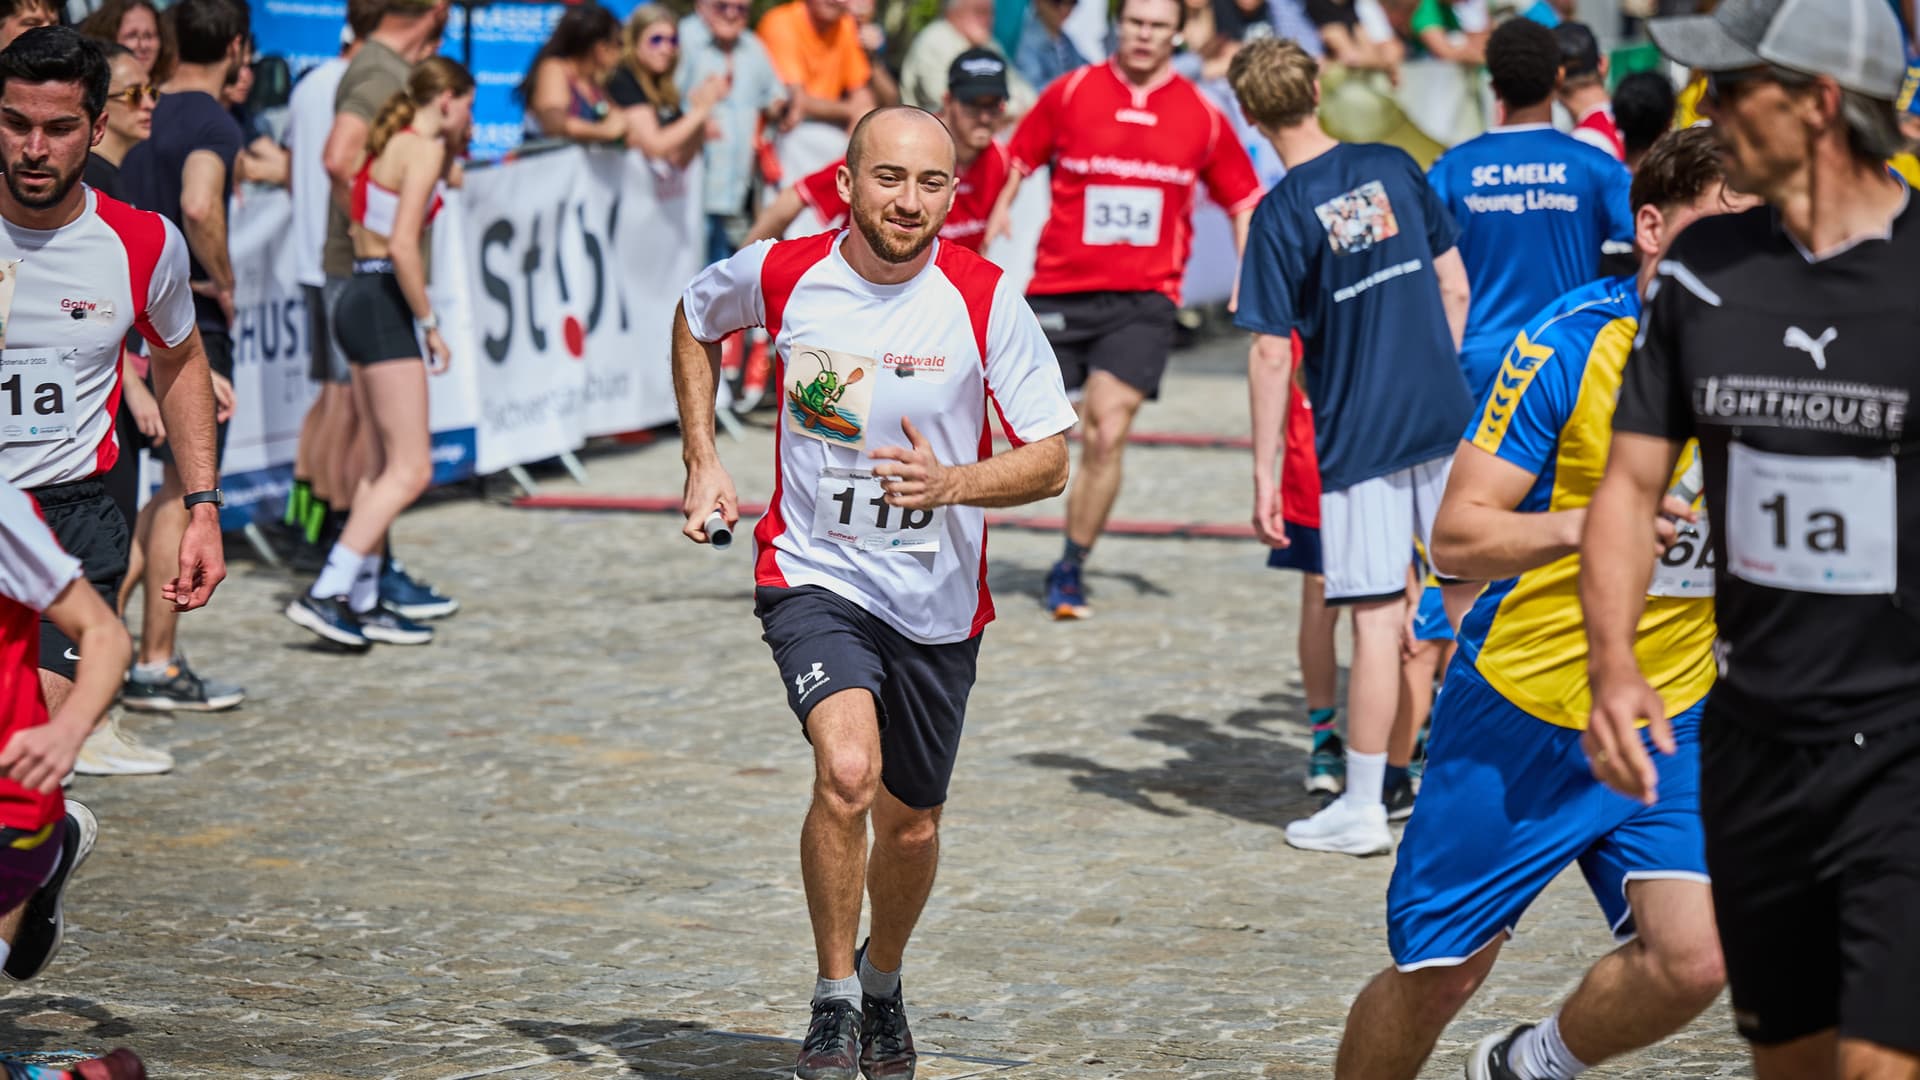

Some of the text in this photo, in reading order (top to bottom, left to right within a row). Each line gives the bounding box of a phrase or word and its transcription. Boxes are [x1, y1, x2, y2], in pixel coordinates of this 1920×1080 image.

[1472, 163, 1567, 187] SC MELK
[1464, 189, 1578, 214] Young Lions
[1094, 203, 1152, 229] 33a
[61, 298, 97, 312] Gottw
[883, 353, 946, 367] Gottwald
[1, 374, 64, 415] 1a
[832, 487, 934, 529] 11b
[1760, 491, 1847, 555] 1a
